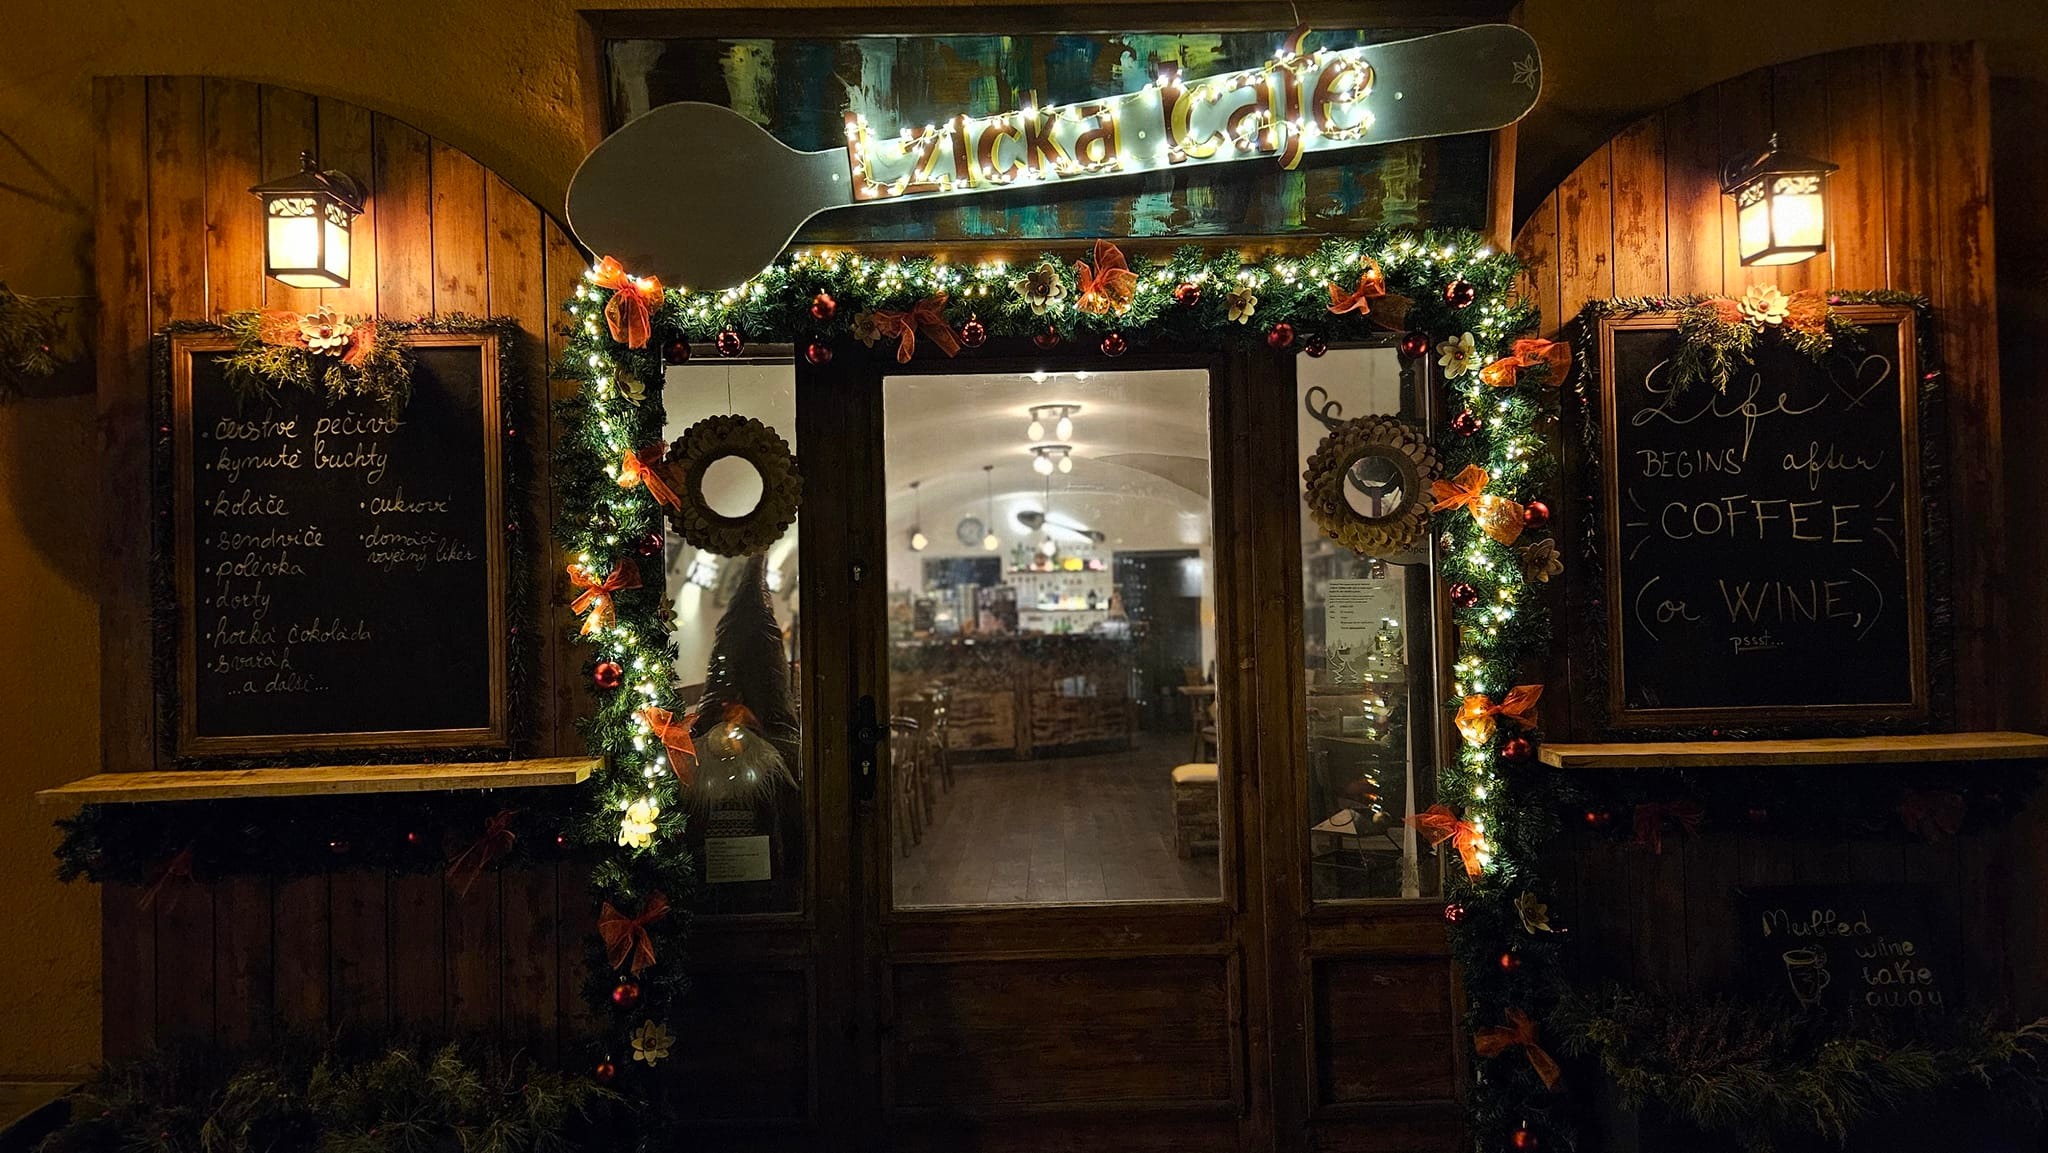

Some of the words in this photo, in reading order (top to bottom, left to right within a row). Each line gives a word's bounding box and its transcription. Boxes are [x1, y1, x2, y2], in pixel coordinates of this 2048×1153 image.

[1631, 359, 1830, 462] Life
[314, 440, 388, 484] buchty
[1636, 448, 1742, 478] BEGINS
[1782, 441, 1885, 491] after
[1661, 494, 1864, 544] COFFEE
[215, 580, 271, 620] dorty
[1762, 909, 1872, 937] Mulled
[1855, 936, 1916, 959] wine
